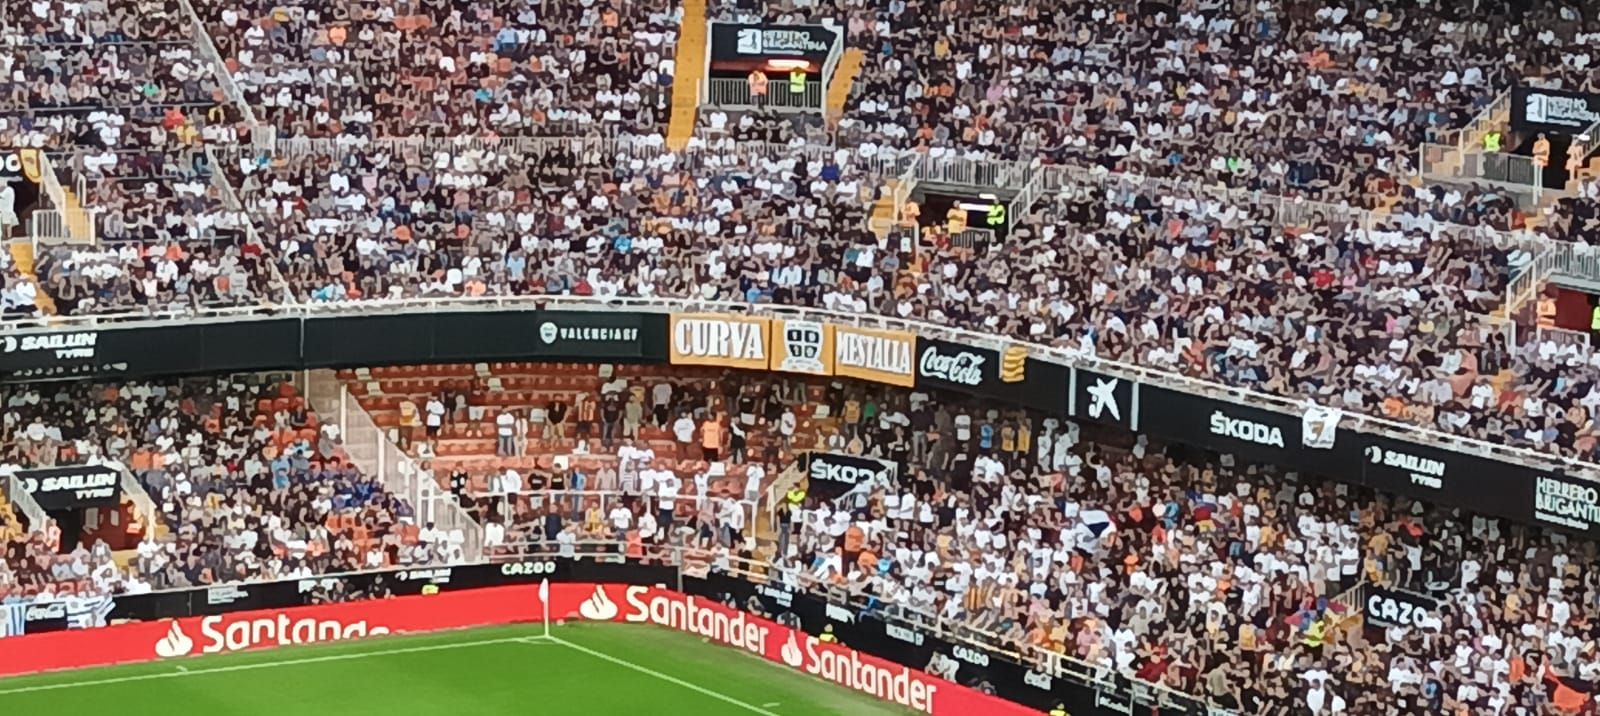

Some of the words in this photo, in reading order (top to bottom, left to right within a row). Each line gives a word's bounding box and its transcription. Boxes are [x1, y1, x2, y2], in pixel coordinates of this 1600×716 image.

[20, 332, 98, 351] SAILUN
[675, 319, 764, 360] CURVA
[836, 331, 912, 374] MESTALLA
[1210, 409, 1285, 449] ŠKODA
[810, 458, 889, 486] ŠKOD
[1383, 450, 1446, 477] SAILUN
[41, 471, 118, 492] SAILUN
[1536, 476, 1599, 505] HERRERO
[501, 561, 556, 576] CAZOO
[625, 585, 769, 656] Santander
[1368, 594, 1430, 629] CAZO
[201, 612, 393, 653] Santand
[805, 635, 937, 714] Santander
